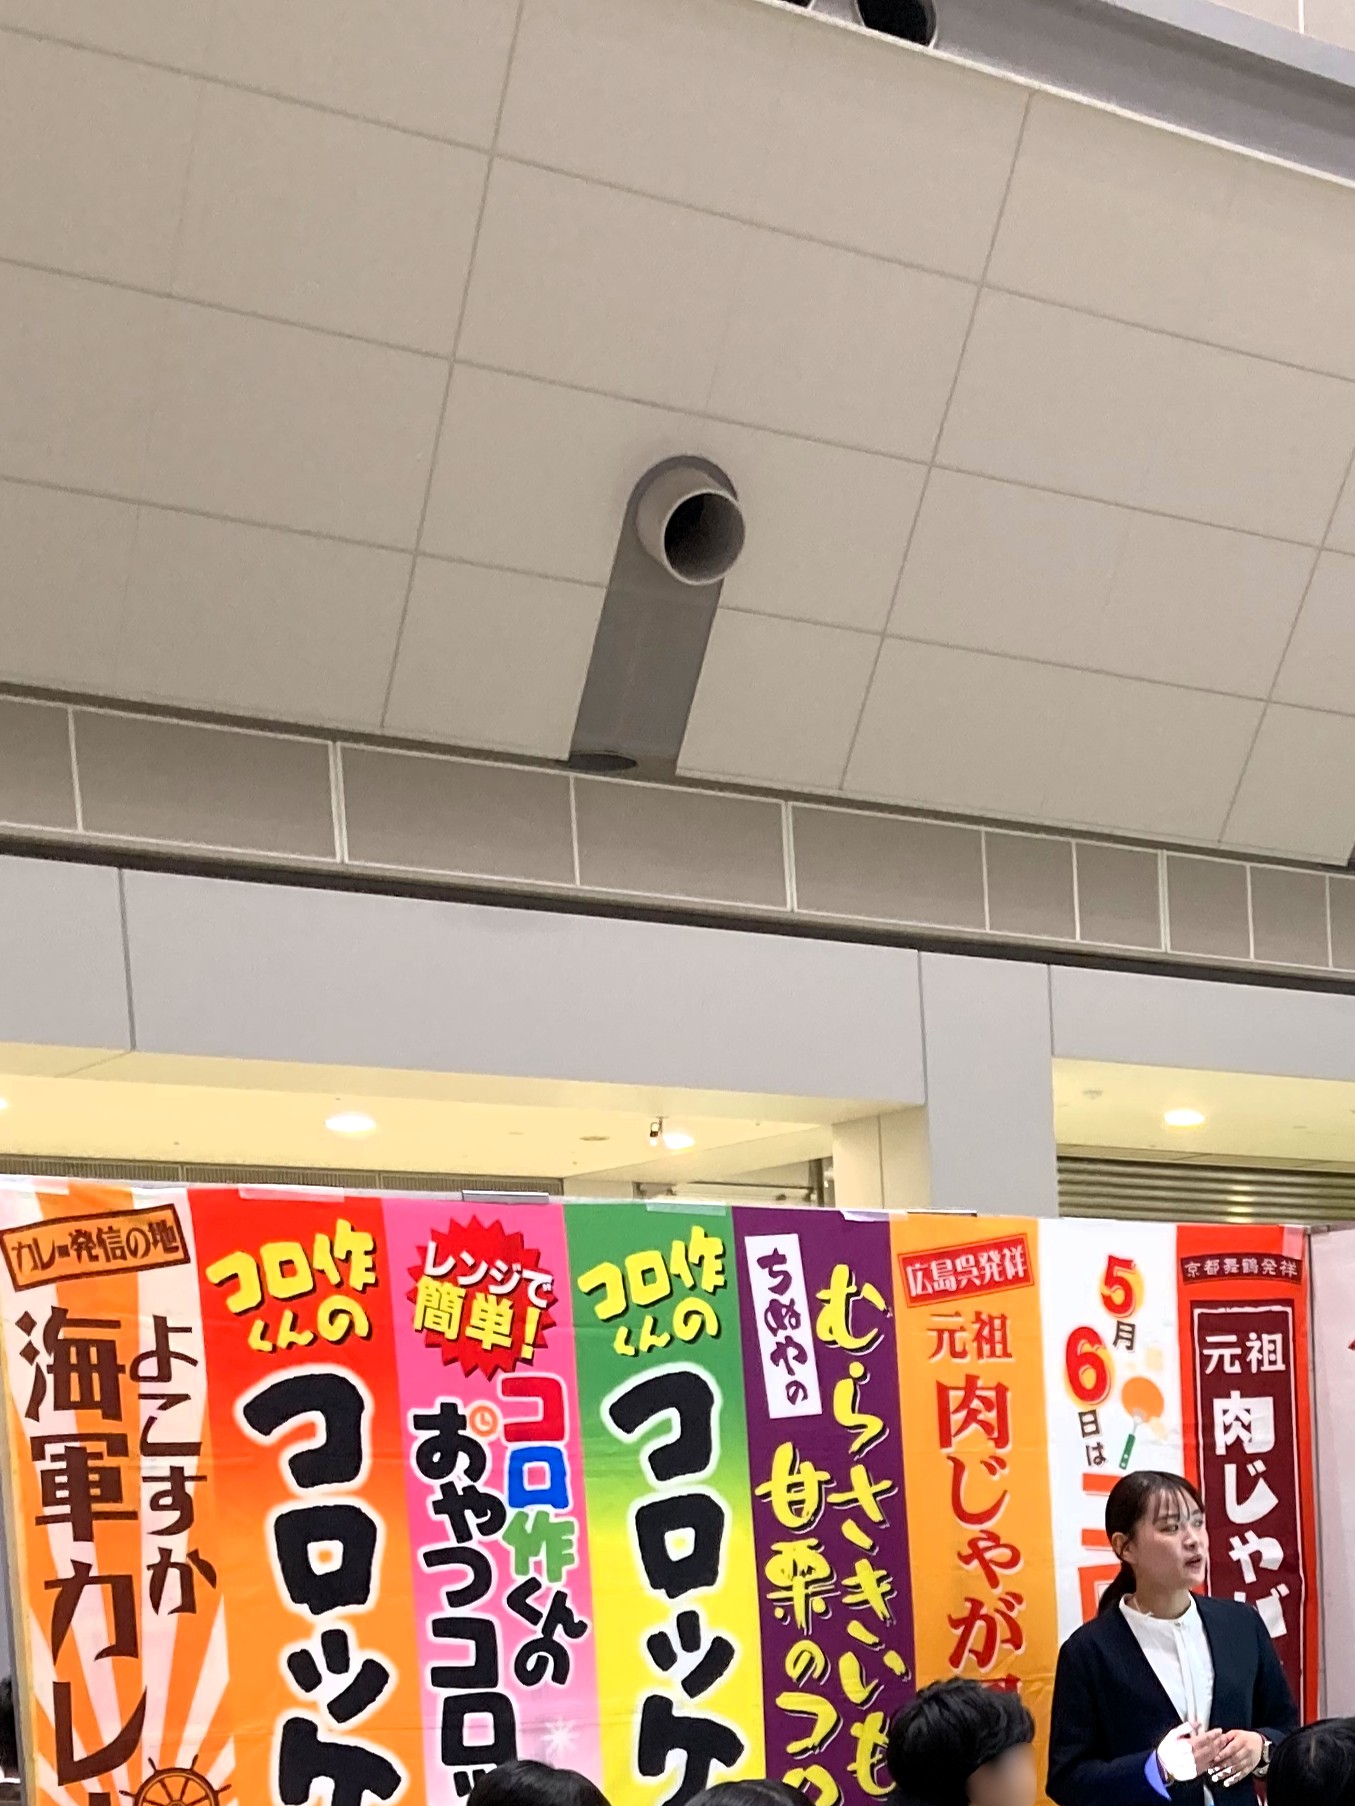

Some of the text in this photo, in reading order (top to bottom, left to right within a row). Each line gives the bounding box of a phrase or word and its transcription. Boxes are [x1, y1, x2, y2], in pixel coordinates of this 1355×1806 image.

[11, 1219, 180, 1274] カレー発信の地
[207, 1217, 380, 1312] コロ作
[578, 1225, 727, 1314] コロ作
[906, 1245, 1028, 1297] 広島呉発祥
[1185, 1258, 1298, 1278] 京都舞鶴発祥
[425, 1248, 557, 1309] レンジで
[249, 1302, 372, 1355] くんの
[413, 1283, 541, 1362] 簡単!
[615, 1301, 721, 1357] くんの
[756, 1247, 811, 1407] ちぬやの
[926, 1311, 1015, 1361] 元祖
[1203, 1332, 1286, 1374] 元祖
[127, 1313, 218, 1616] よこすか
[501, 1376, 588, 1686] コロ作くんの
[938, 1372, 1026, 1692] 肉じゃが
